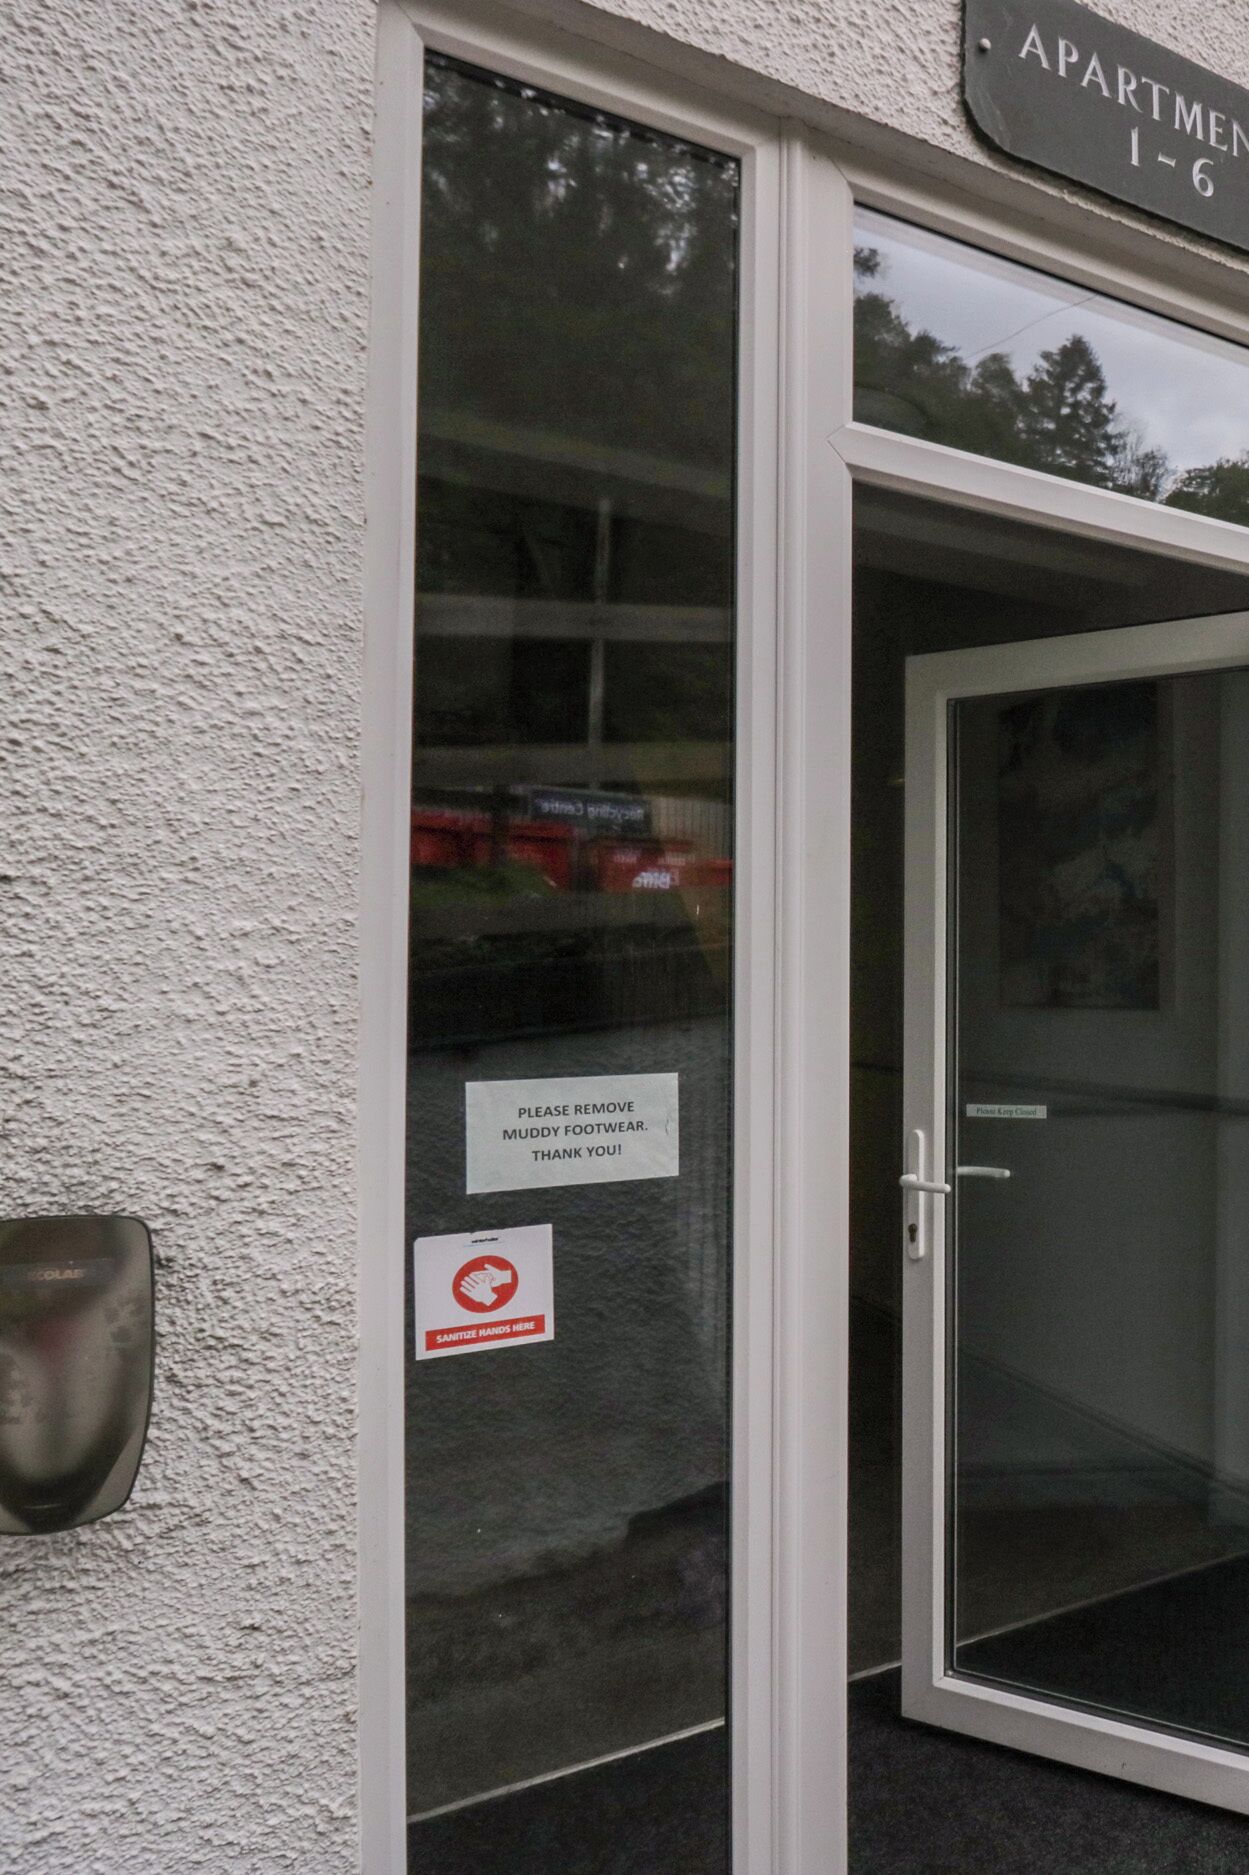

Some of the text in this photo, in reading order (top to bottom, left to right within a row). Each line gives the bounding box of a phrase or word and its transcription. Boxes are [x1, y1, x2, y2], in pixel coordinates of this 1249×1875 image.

[518, 1101, 635, 1119] PLEASE REMOVE
[502, 1121, 649, 1141] MUDDY FOOTWEAR.
[532, 1144, 622, 1162] THANK YOU!
[436, 1321, 536, 1344] SANITIZE HANDS HERE
